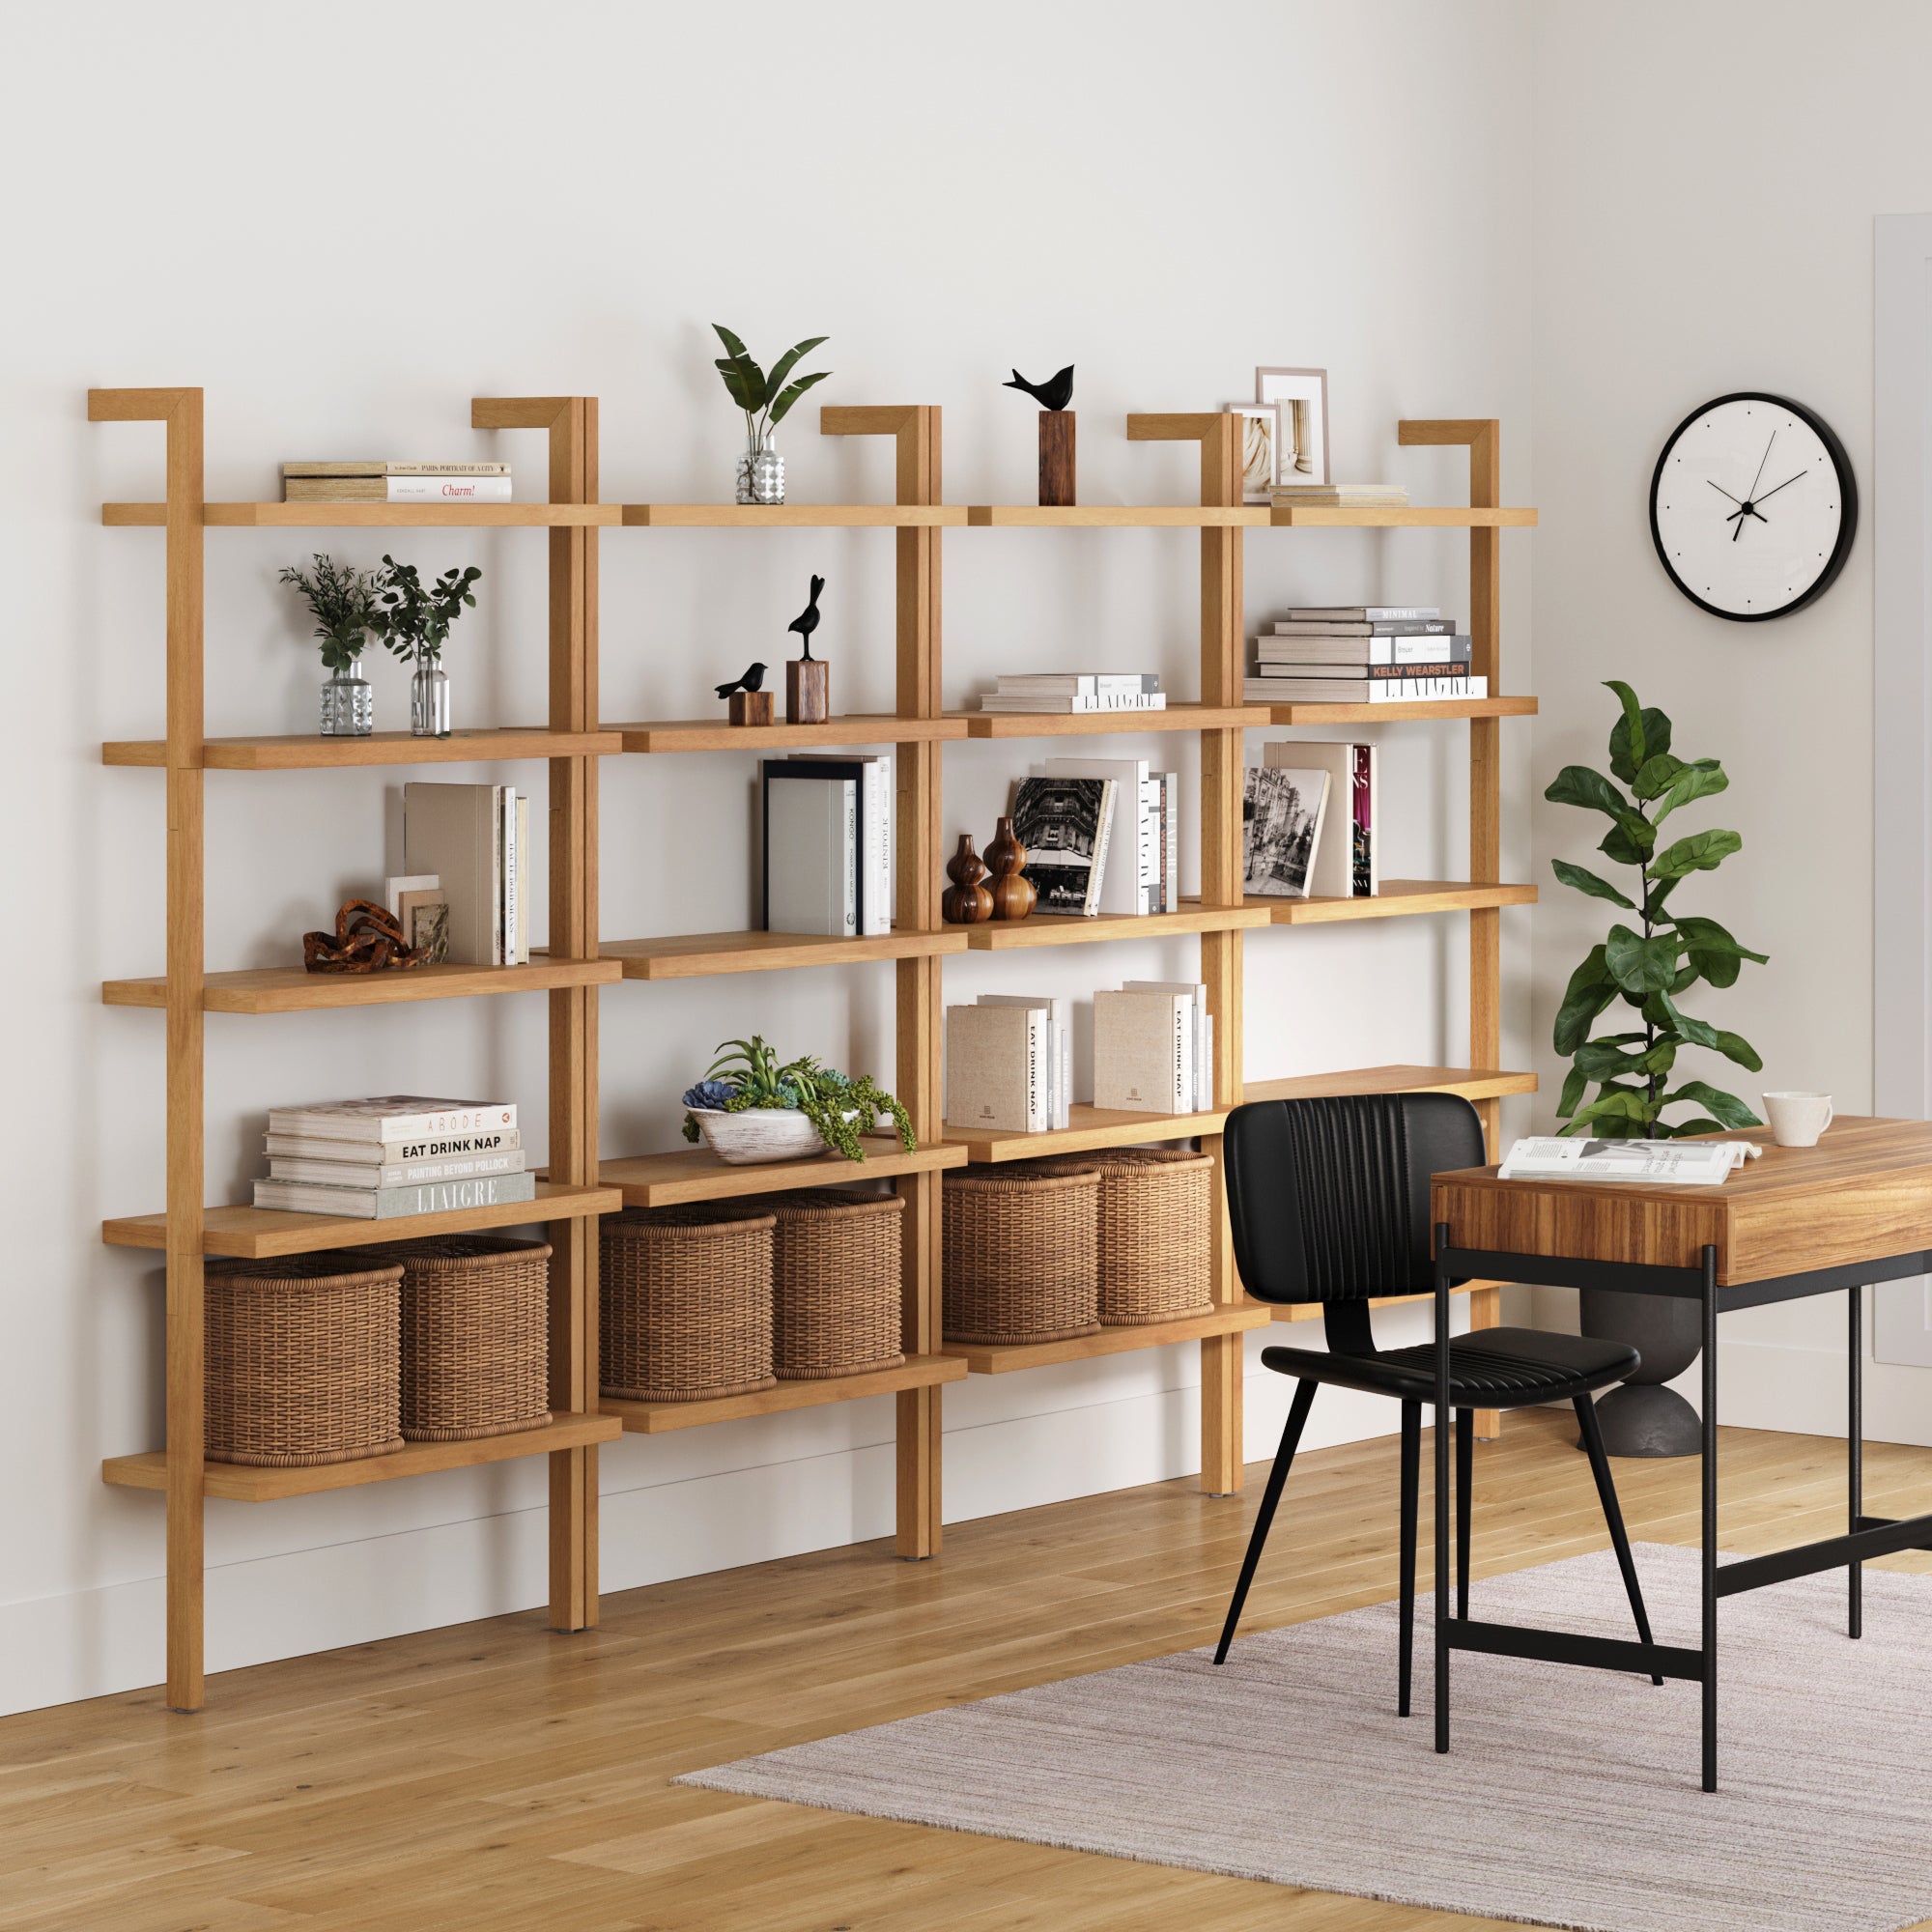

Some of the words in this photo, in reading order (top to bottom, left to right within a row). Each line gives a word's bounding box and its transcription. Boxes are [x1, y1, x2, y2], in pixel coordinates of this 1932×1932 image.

[441, 483, 475, 497] Charm!
[1382, 610, 1417, 619] MINIMAL
[1425, 624, 1445, 633] Nature
[1374, 667, 1404, 677] KELLY
[1406, 665, 1464, 676] WEARSTLER
[1167, 808, 1177, 879] LIAIGRE
[428, 1114, 481, 1131] ABODE
[402, 1145, 426, 1158] EAT
[430, 1140, 470, 1155] DRINK
[474, 1136, 501, 1150] NAP
[408, 1165, 442, 1179] PAINTING
[444, 1161, 473, 1175] BEYOND
[475, 1157, 509, 1172] POLLOCK
[417, 1179, 497, 1212] LIAIGRE
